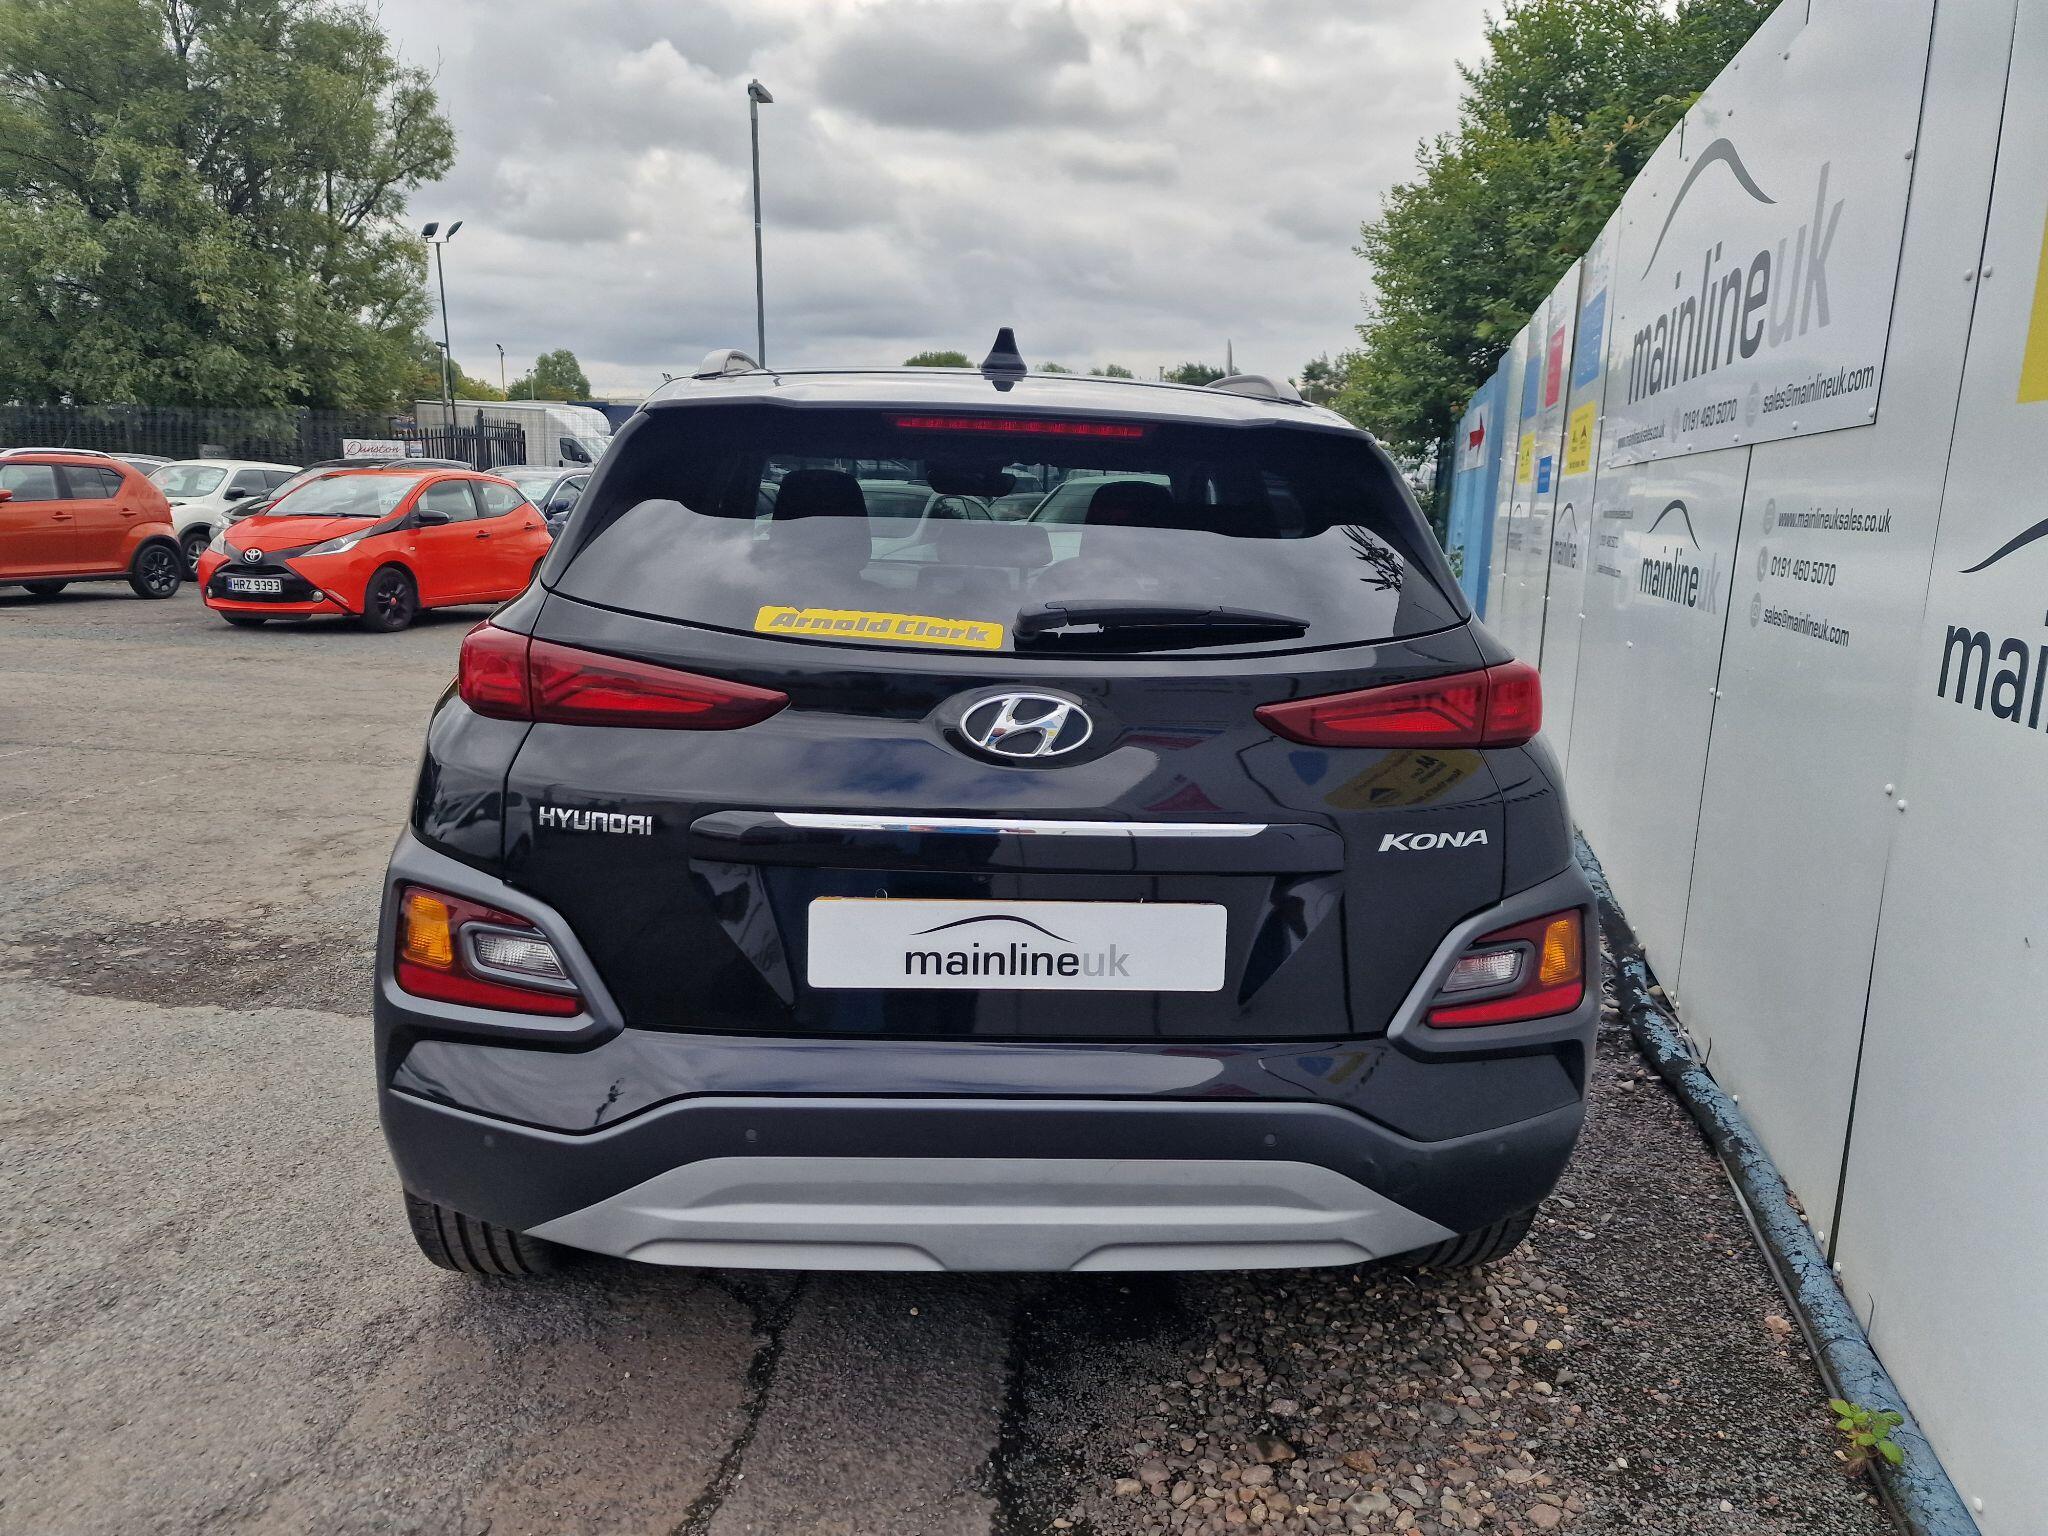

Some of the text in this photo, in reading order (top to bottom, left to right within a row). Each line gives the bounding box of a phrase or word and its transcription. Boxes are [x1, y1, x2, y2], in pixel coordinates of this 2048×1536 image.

[1627, 160, 1845, 405] mainlineuk
[1762, 365, 1875, 414] sales@mainlineuk.com
[1682, 398, 1738, 433] 0191 460 5070
[345, 441, 401, 456] Dunston
[1778, 508, 1892, 533] www.mainlineuksales.co.uk
[233, 579, 280, 591] HRZ 9393
[1770, 555, 1837, 587] 0191 460 5070
[768, 612, 991, 642] Arnold Clark
[1763, 605, 1850, 647] sales@mainlineuk.com
[1937, 609, 2048, 734] mai
[539, 806, 653, 836] HYUNDAI
[1378, 829, 1489, 852] KONA
[905, 942, 1131, 977] mainlineuk
